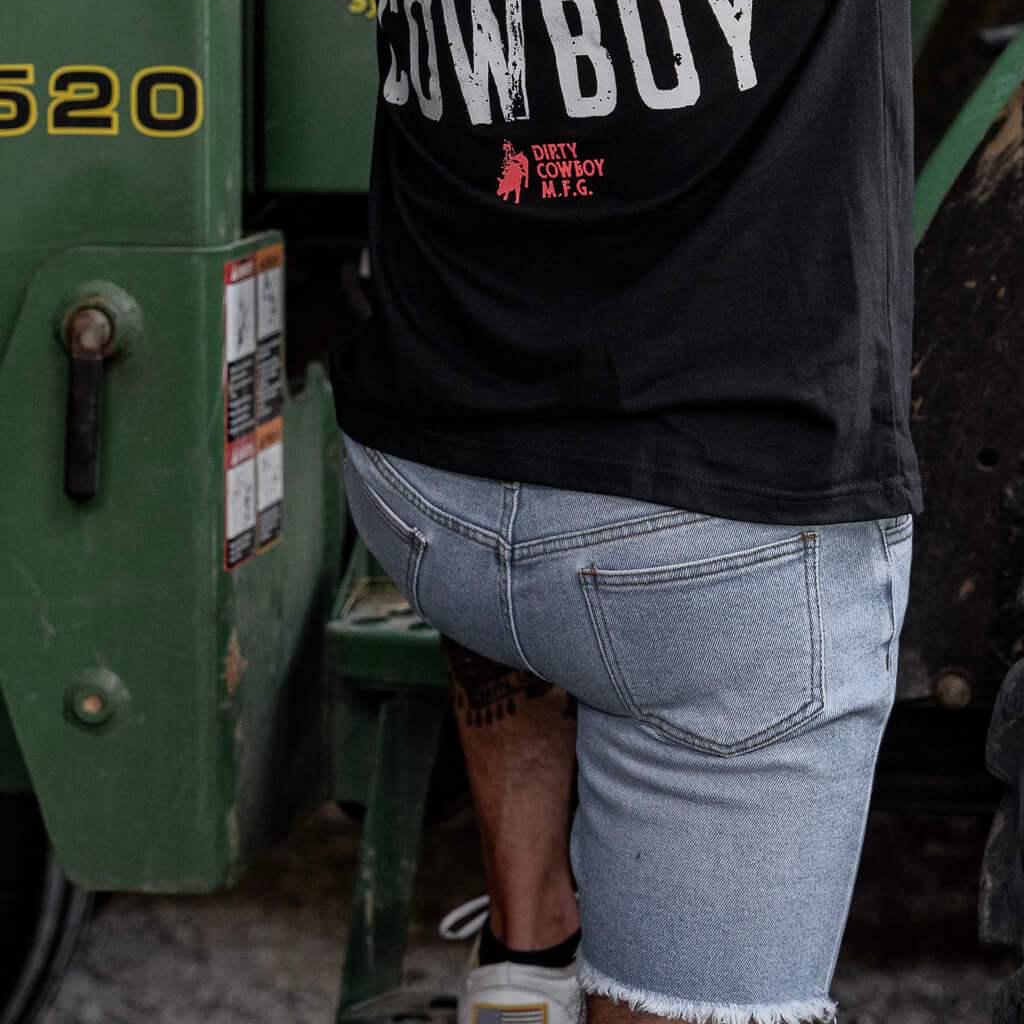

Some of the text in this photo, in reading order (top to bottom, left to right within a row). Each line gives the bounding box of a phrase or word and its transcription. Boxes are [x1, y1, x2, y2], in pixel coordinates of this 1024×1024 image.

[531, 142, 578, 161] DIRTY
[536, 158, 606, 179] COWBOY
[541, 178, 594, 199] M.F.G.
